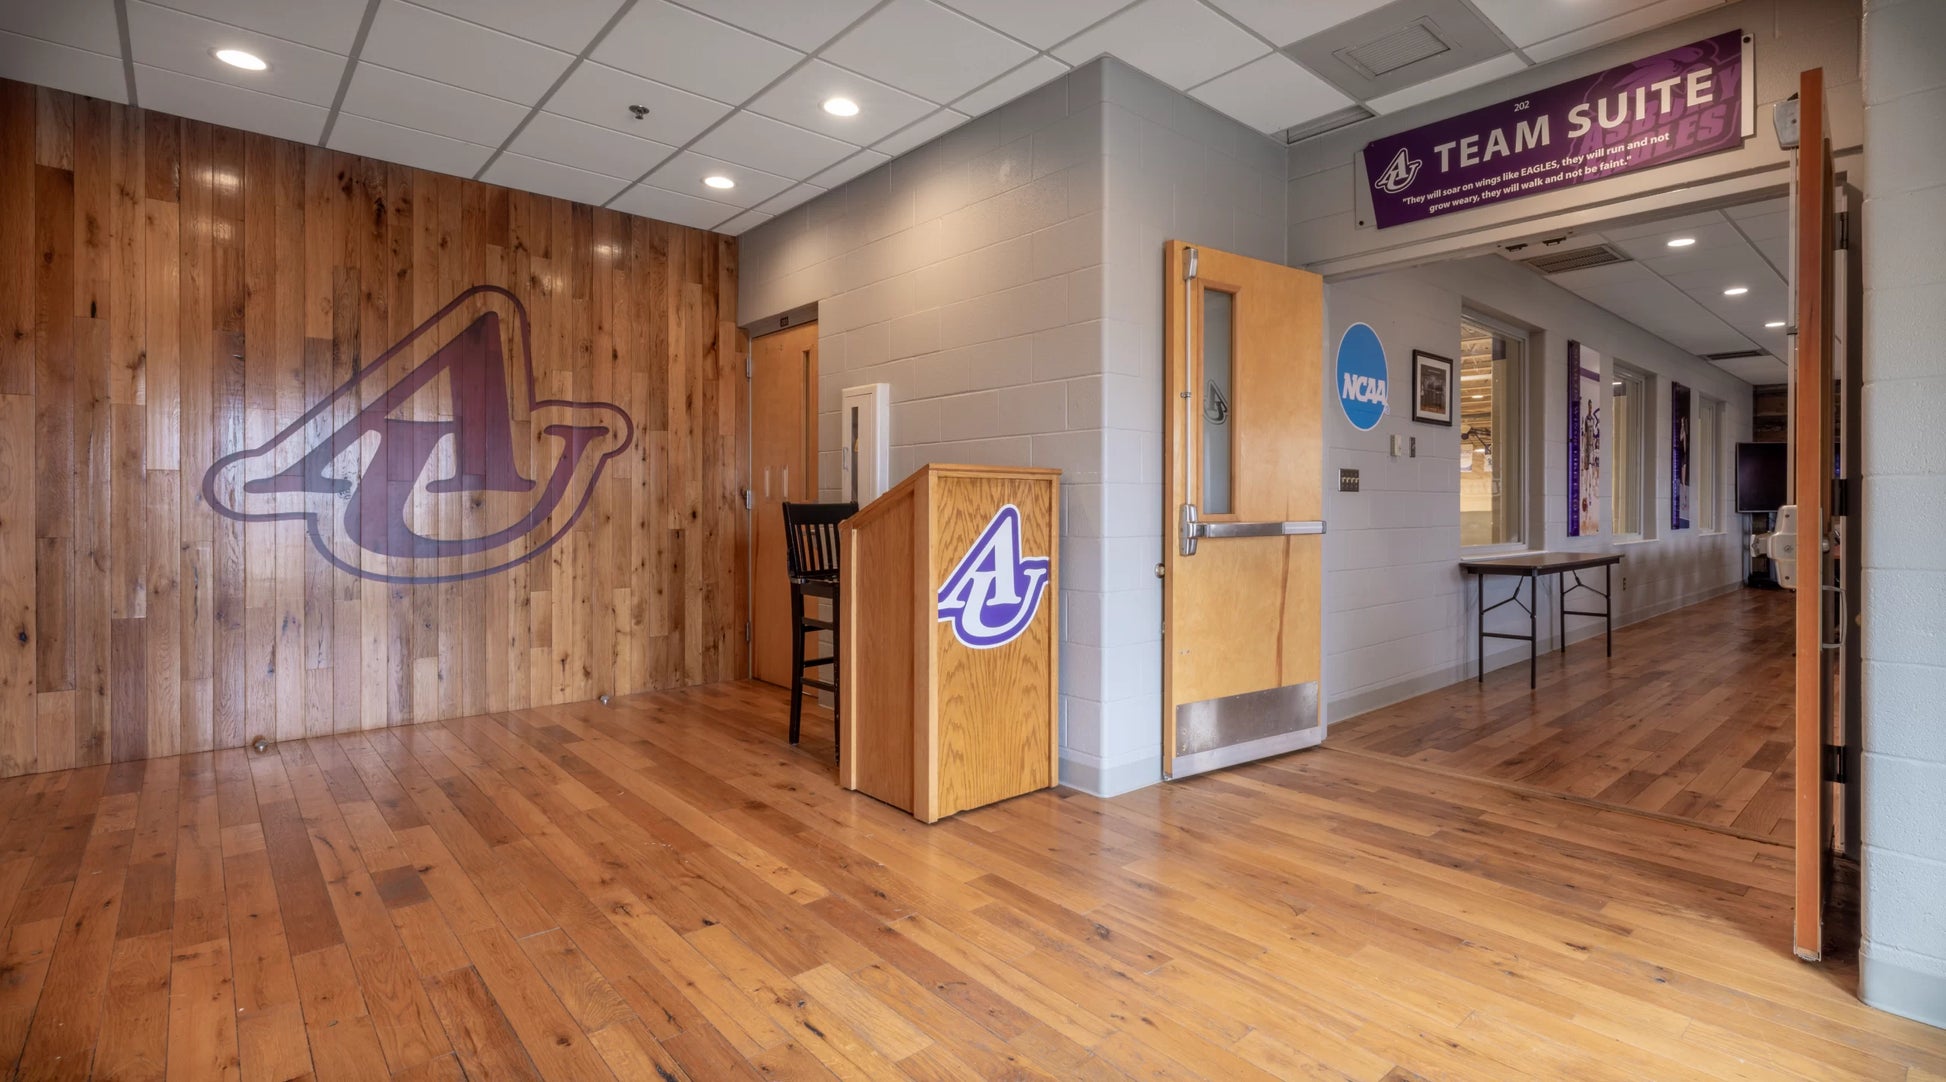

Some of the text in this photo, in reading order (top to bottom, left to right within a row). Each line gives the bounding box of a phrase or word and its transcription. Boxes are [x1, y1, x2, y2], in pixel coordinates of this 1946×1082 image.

[1434, 67, 1713, 173] TEAM SUITE
[1514, 100, 1530, 112] 202
[1376, 149, 1421, 193] AU
[1402, 133, 1670, 205] "They will soar on wings like EAGLES, they will run and not
[1429, 155, 1632, 214] grow weary, they will walk and not be faint."
[1342, 372, 1388, 406] NCAA
[225, 300, 620, 570] AU
[938, 508, 1048, 645] AU
